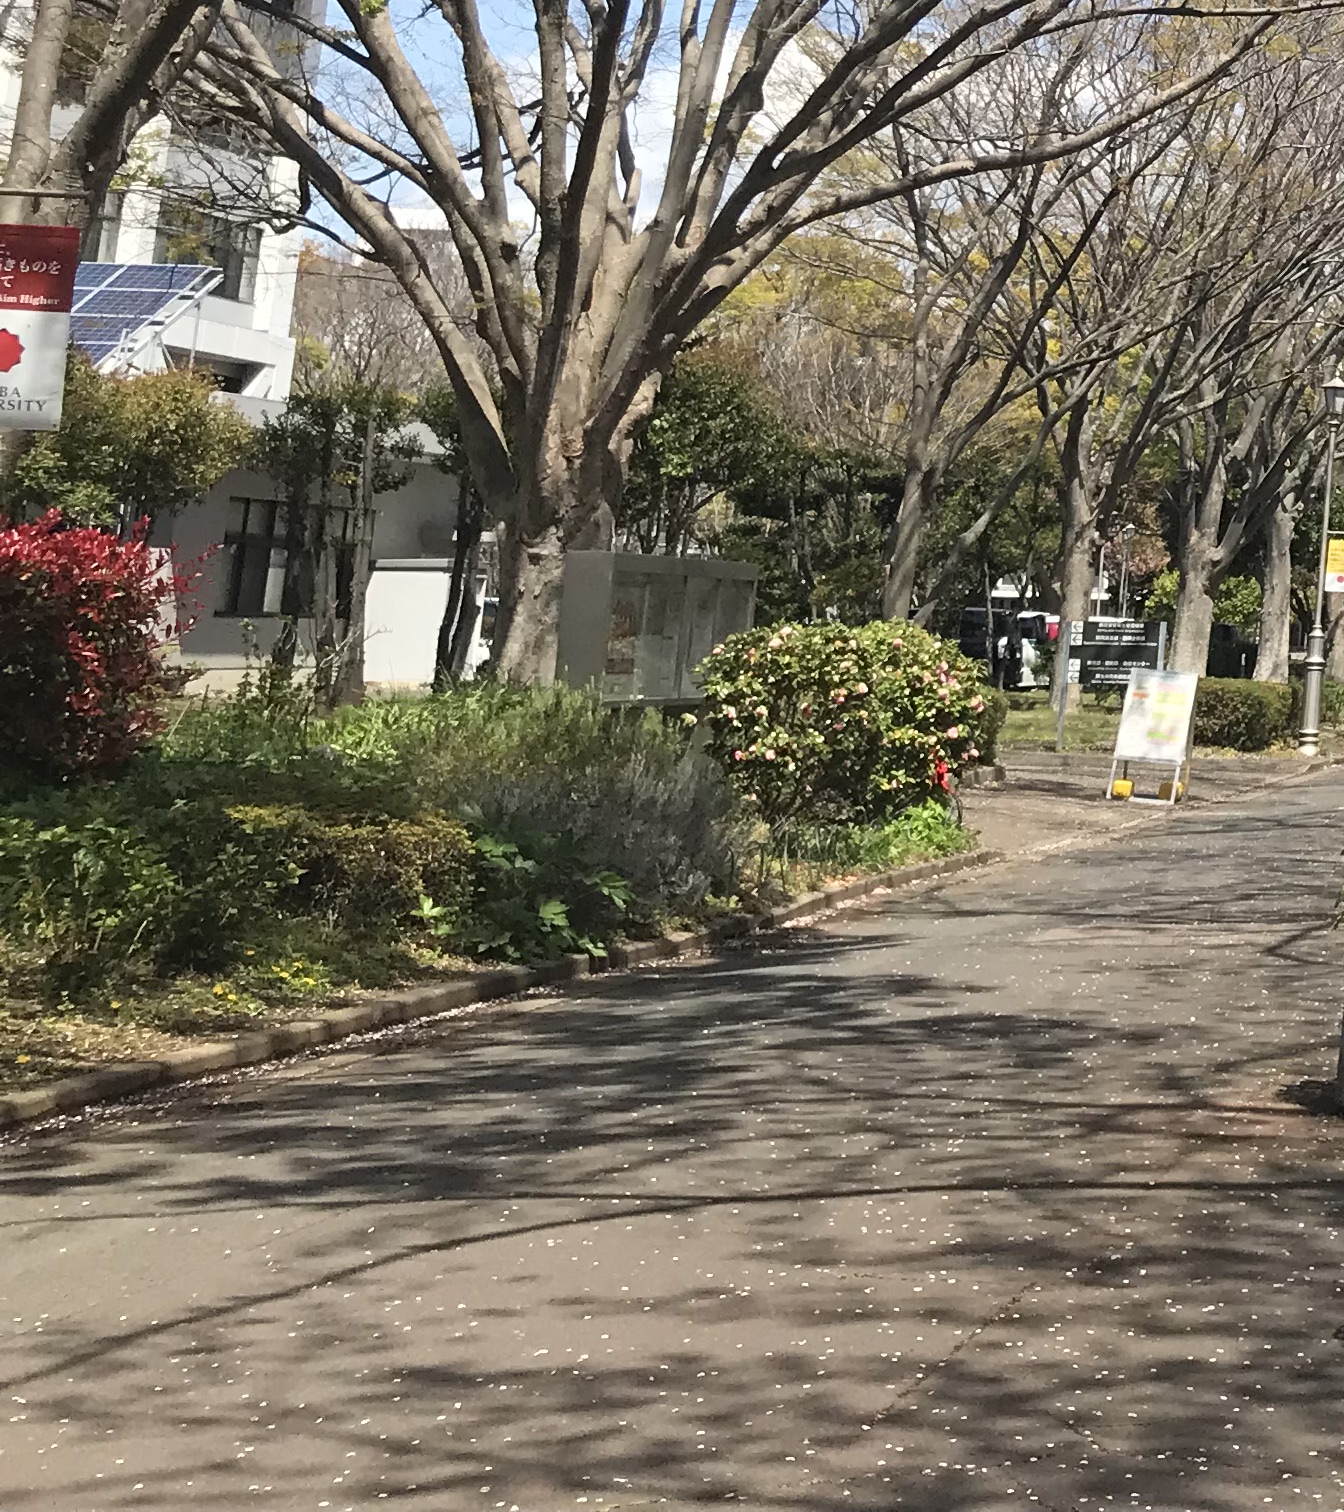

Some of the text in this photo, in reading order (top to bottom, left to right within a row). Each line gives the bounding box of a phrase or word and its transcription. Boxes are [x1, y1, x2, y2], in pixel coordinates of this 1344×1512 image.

[0, 258, 61, 274] きものを
[20, 294, 60, 305] Higher
